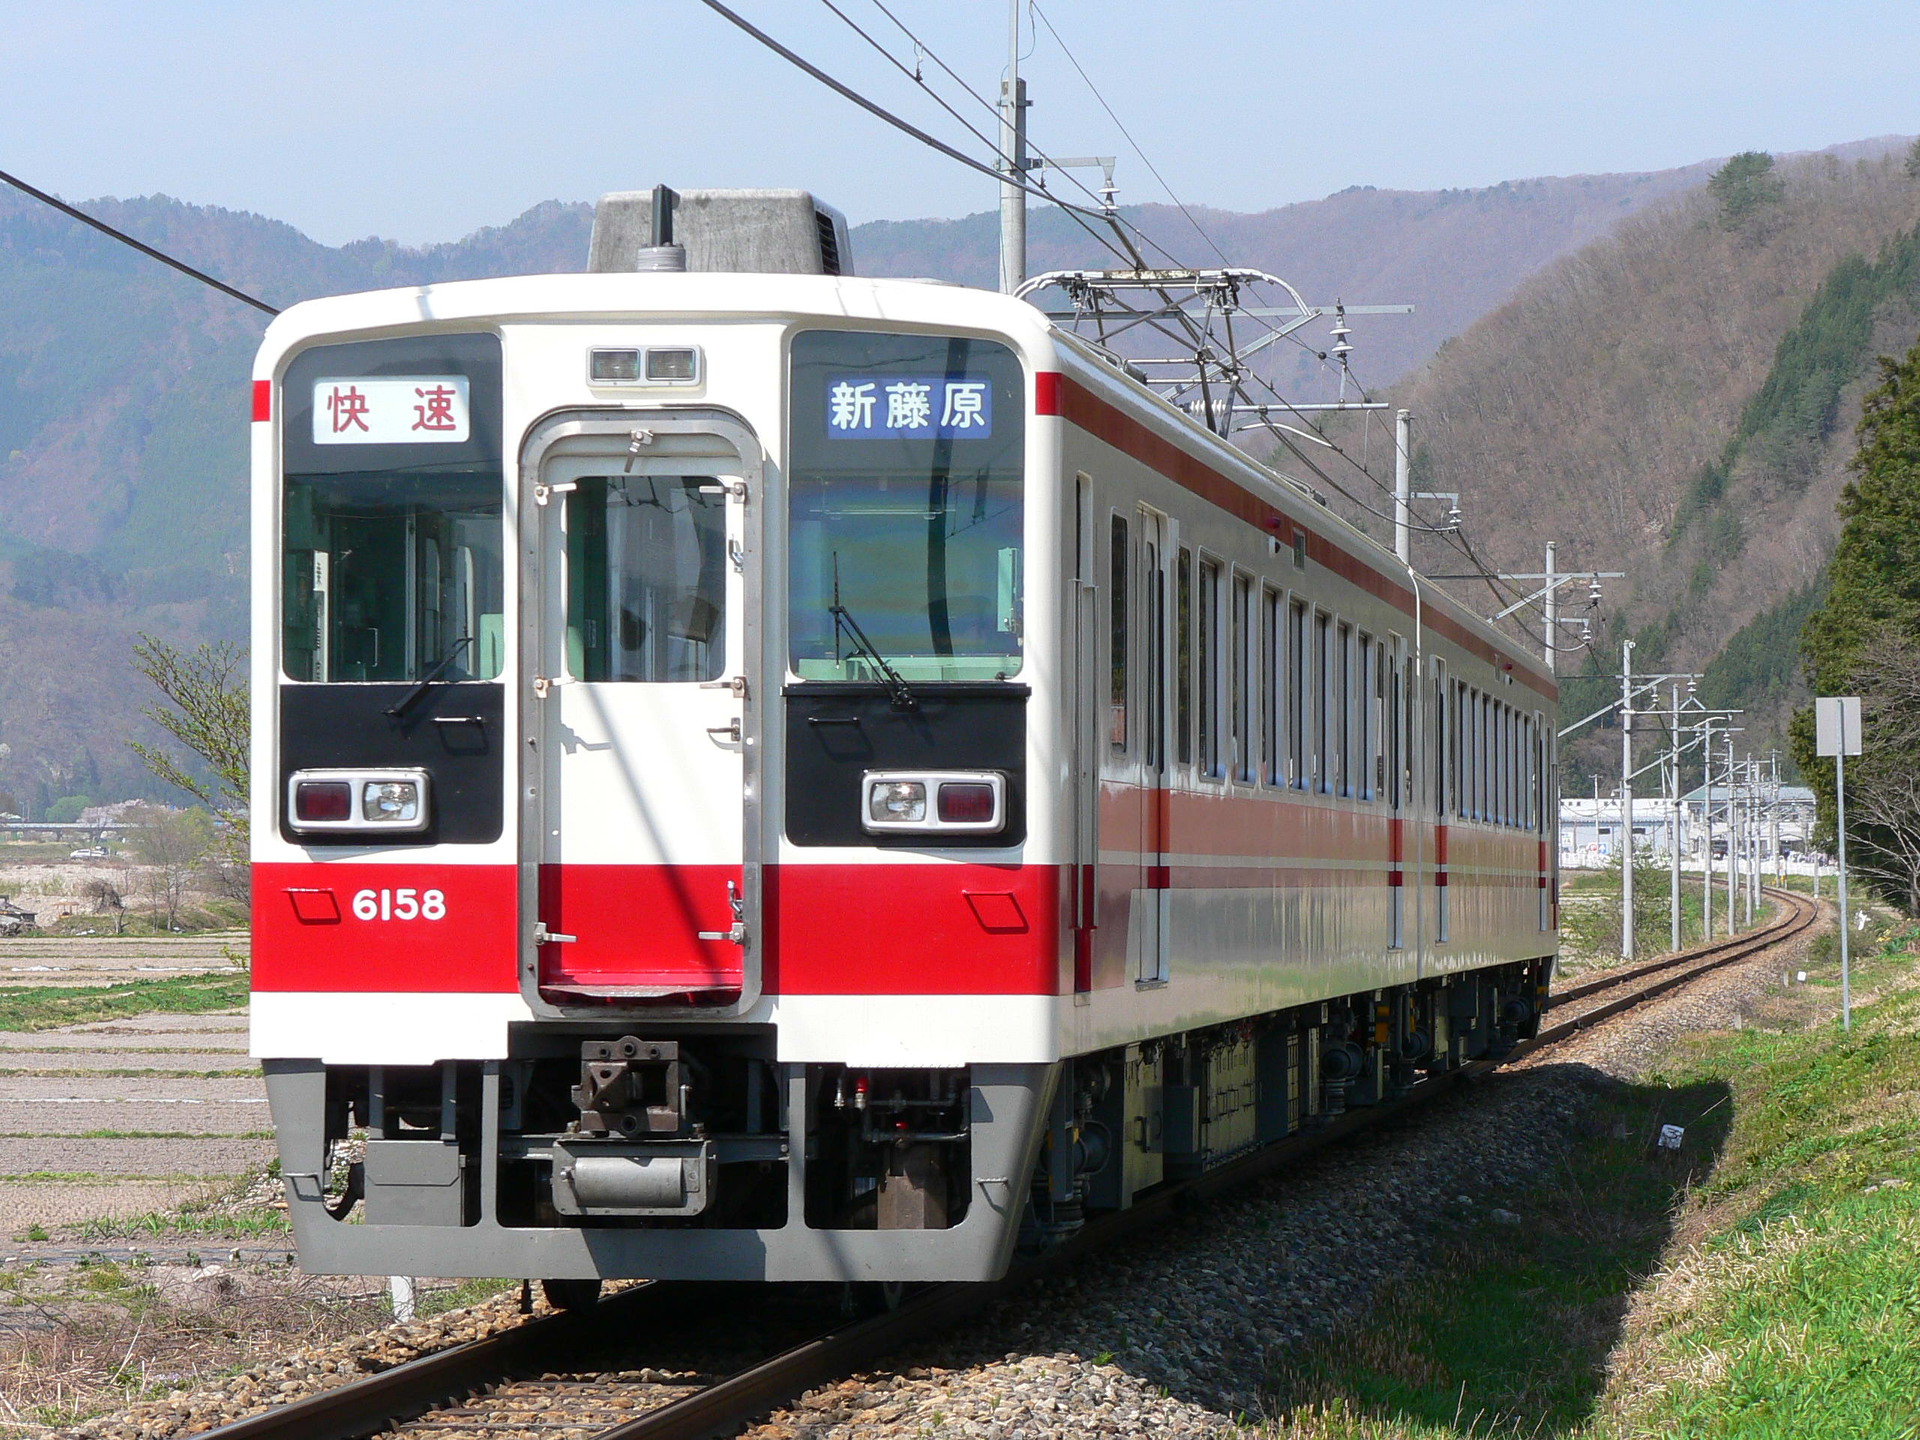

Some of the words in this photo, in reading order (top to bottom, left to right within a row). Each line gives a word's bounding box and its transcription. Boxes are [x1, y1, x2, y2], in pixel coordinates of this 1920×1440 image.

[327, 384, 456, 433] 快速
[831, 381, 986, 430] 新藤原
[352, 888, 447, 921] 6158
